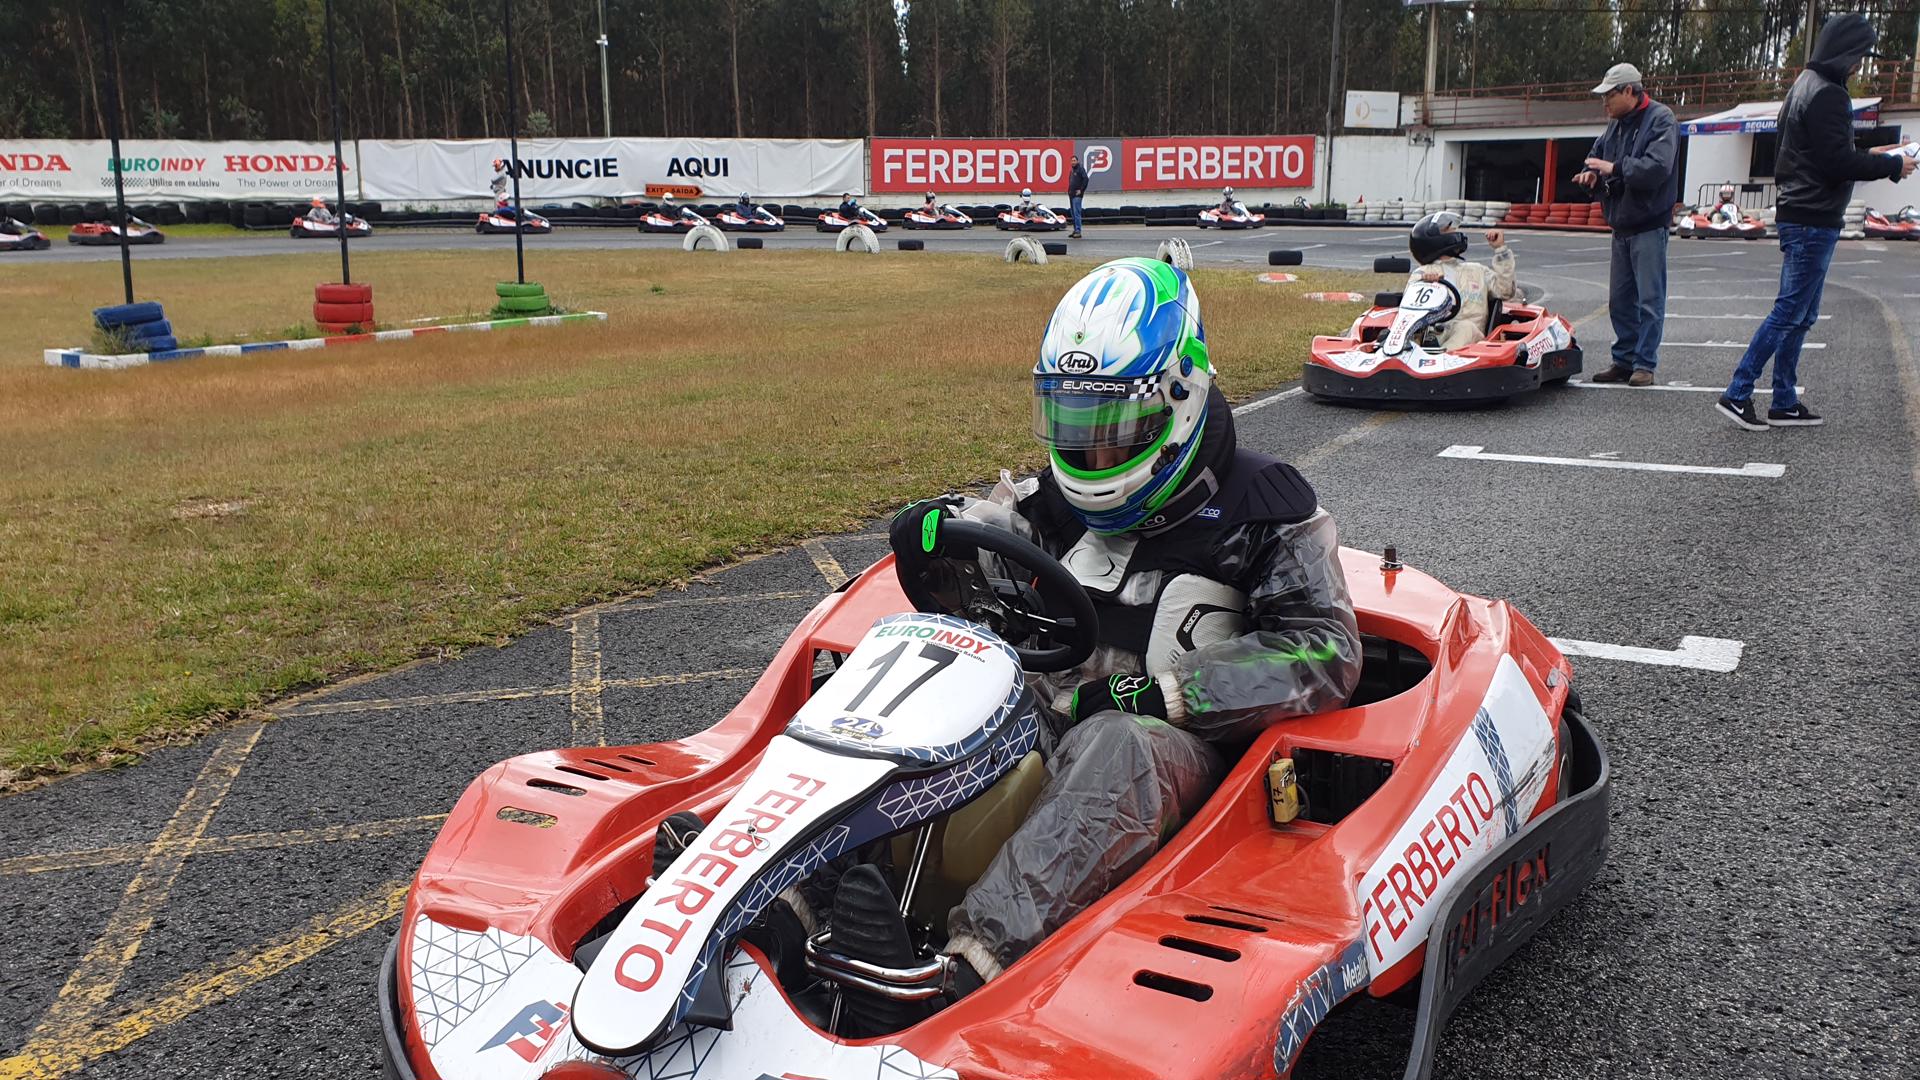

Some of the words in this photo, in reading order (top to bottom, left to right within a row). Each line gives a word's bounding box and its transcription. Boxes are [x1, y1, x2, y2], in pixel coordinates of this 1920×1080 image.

[1745, 121, 1777, 129] SEGURA
[0, 154, 71, 170] NDA
[224, 155, 349, 172] HONDA
[504, 158, 619, 178] ANUNCIE
[667, 158, 729, 178] AQUI
[884, 148, 1063, 184] FERBERTO
[1135, 145, 1304, 181] FERBERTO
[23, 178, 62, 187] Dreams
[237, 178, 256, 187] The
[260, 178, 290, 187] Power
[305, 178, 337, 187] Dream
[1415, 287, 1434, 304] 16
[1060, 353, 1092, 369] Arai
[1063, 380, 1126, 392] EUROPA
[875, 624, 992, 654] EUROINDY
[843, 640, 960, 718] 17
[1363, 772, 1494, 963] FERBERTO
[614, 773, 827, 993] FERBERTO
